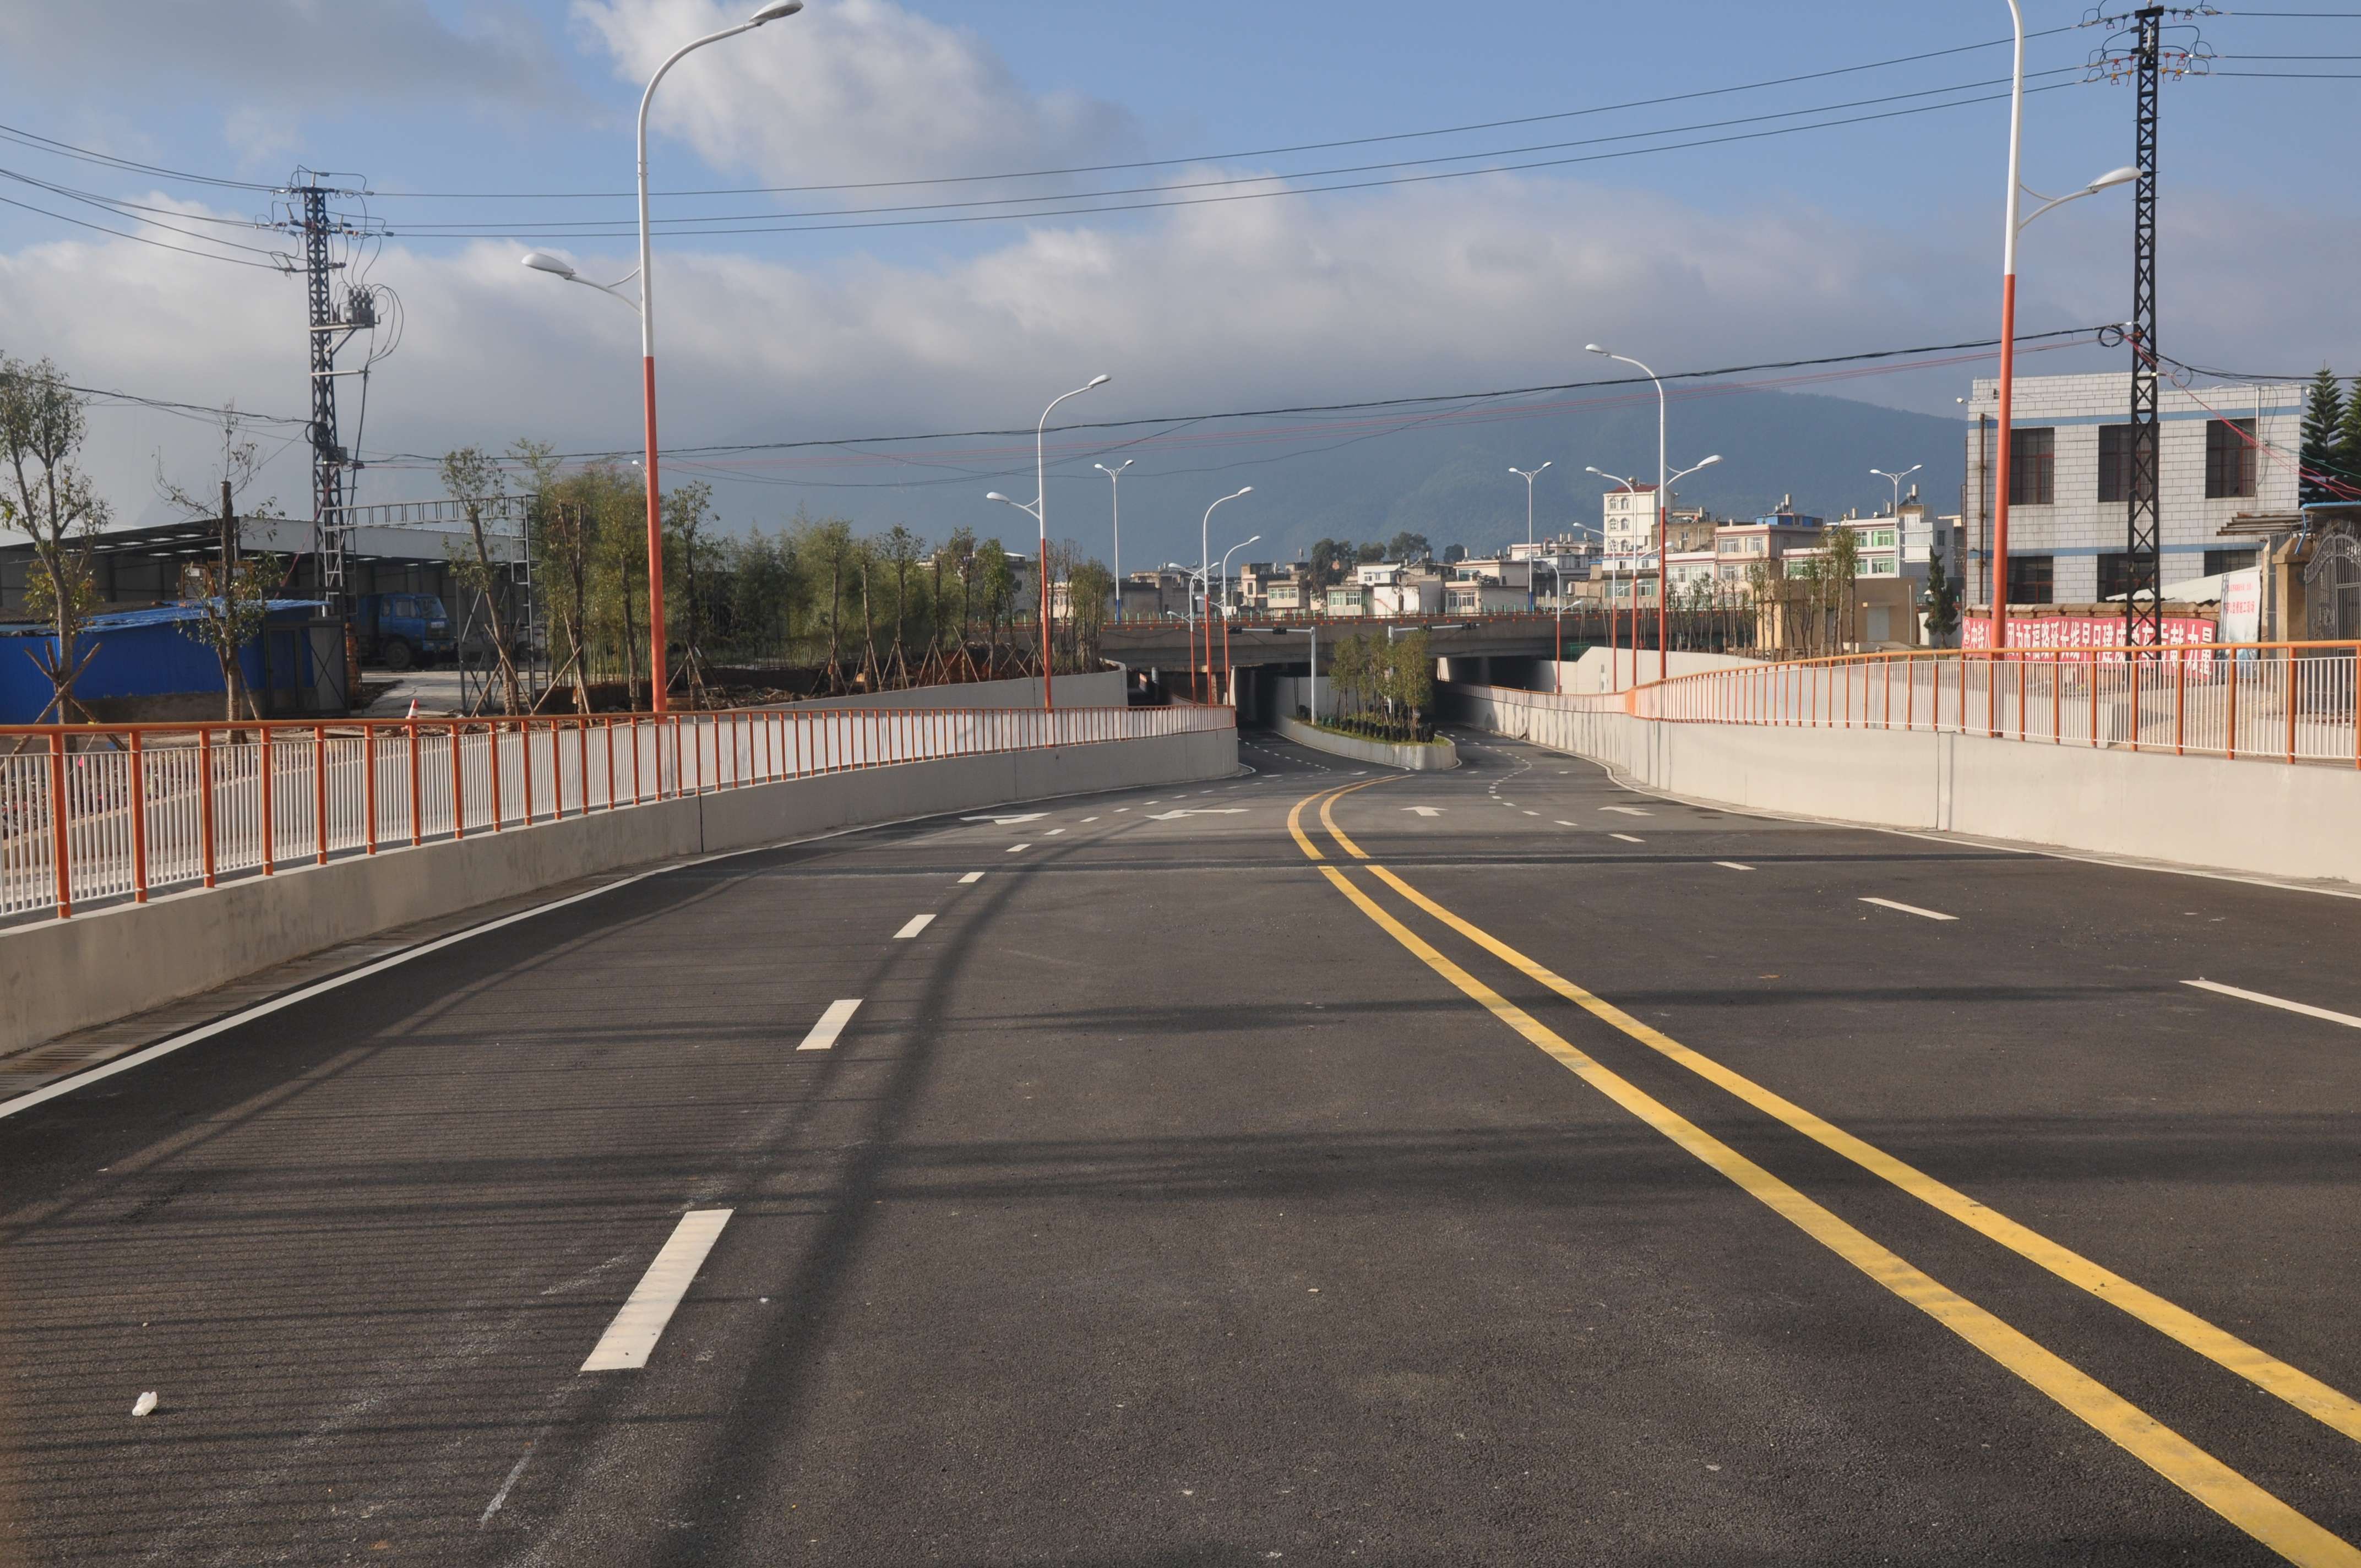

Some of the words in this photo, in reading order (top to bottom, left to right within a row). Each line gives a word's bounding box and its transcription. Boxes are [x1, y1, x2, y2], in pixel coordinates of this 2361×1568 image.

[1970, 620, 2212, 676] 中铁八团为西福路延长线早日建成车献力量
